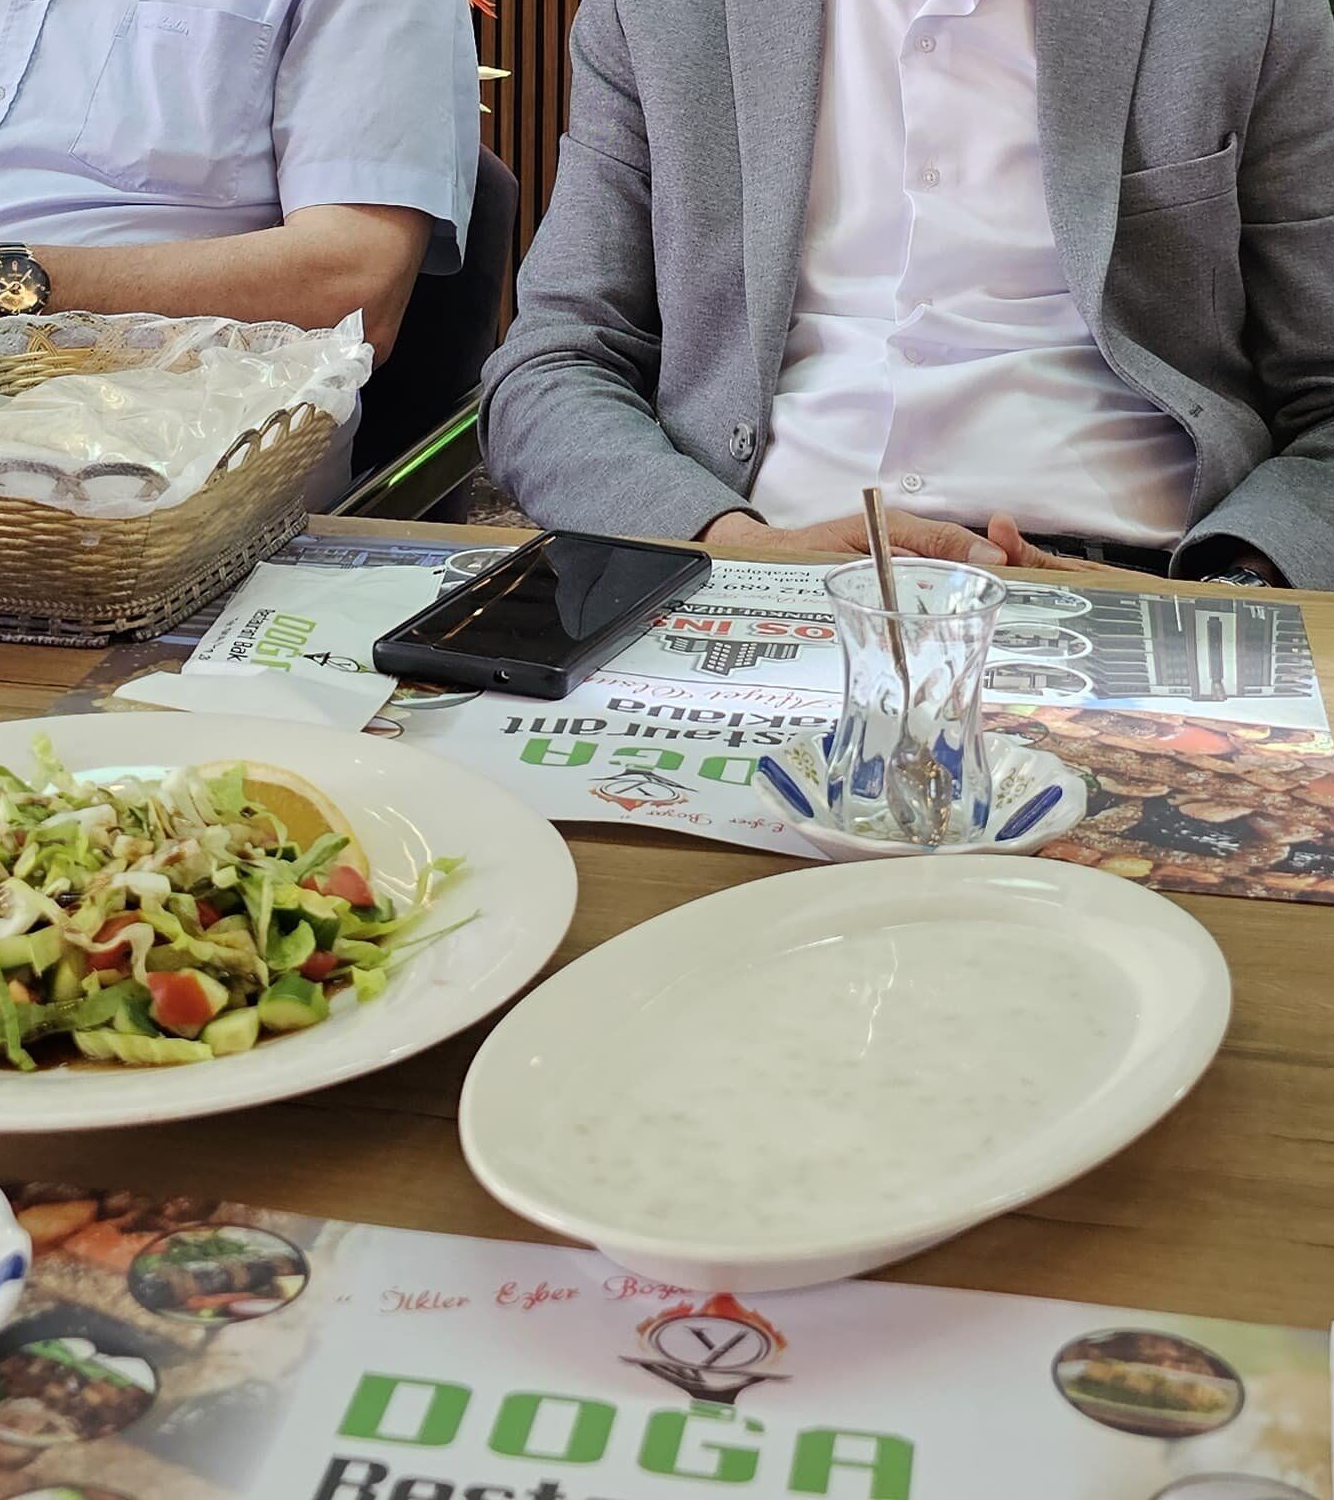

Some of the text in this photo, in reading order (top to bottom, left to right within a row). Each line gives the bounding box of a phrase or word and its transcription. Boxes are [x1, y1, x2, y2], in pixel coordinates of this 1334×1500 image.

[722, 583, 771, 592] 689
[779, 586, 826, 597] 542
[675, 603, 836, 623] MENKUL HİZM
[499, 715, 796, 748] staurant
[645, 809, 785, 834] Ezber Bozar
[493, 1279, 581, 1312] Ezber
